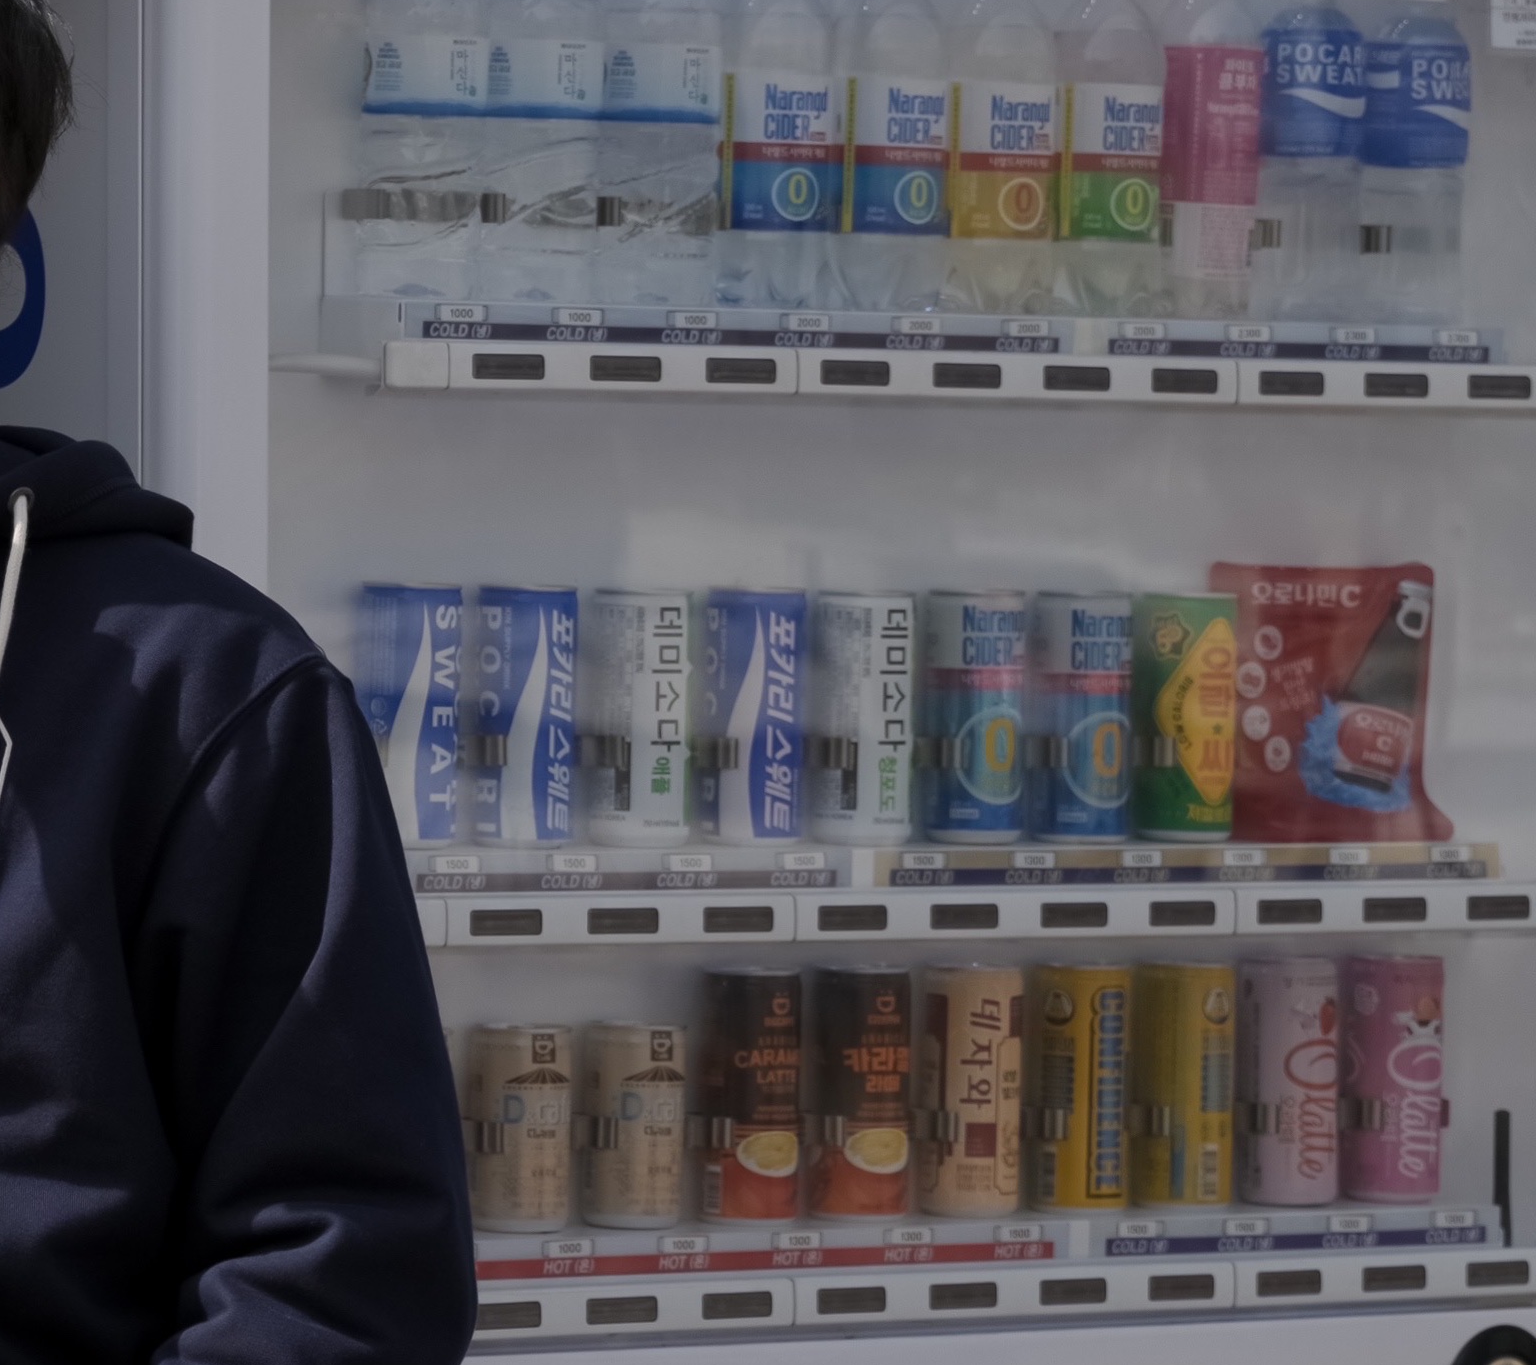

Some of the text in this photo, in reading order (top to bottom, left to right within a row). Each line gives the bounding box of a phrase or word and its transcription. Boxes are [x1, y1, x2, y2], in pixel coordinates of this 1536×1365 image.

[1277, 43, 1364, 65] POCAR
[450, 309, 473, 319] 1000
[568, 313, 591, 323] 1000
[684, 316, 707, 325] 1000
[796, 317, 821, 328] 2000
[908, 320, 933, 331] 2000
[1017, 323, 1040, 334] 2000
[429, 325, 467, 338] COLD
[546, 327, 585, 340] COLD
[661, 330, 699, 343] COLD
[1132, 326, 1155, 336] 2000
[775, 332, 812, 346] COLD
[886, 335, 924, 349] COLD
[995, 338, 1031, 352] COLD
[1114, 341, 1149, 353] COLD
[1220, 343, 1256, 355] COLD
[1251, 583, 1362, 609] 오로나민C
[650, 607, 684, 752] 데미소다
[878, 609, 908, 752] 데미소다
[429, 605, 457, 811] SWEAT
[475, 605, 503, 833] POCRI
[546, 609, 574, 832] 포카리 스웨트
[764, 611, 796, 832] 포카리 스웨트
[650, 756, 671, 794] 애플
[878, 756, 898, 814] 청포도
[446, 860, 468, 869] 1500
[563, 858, 586, 868] 1500
[679, 858, 702, 868] 1500
[793, 856, 815, 866] 1500
[912, 855, 935, 865] 1500
[1023, 855, 1045, 865] 1300
[423, 875, 463, 889] COLD
[541, 875, 580, 889] COLD
[657, 873, 694, 888] COLD
[770, 872, 808, 886] COLD
[895, 870, 932, 884] COLD
[1005, 870, 1040, 884] COLD
[959, 998, 1001, 1109] 데자와
[788, 1236, 811, 1246] 1300
[900, 1231, 922, 1241] 1300
[558, 1243, 581, 1253] 1000
[672, 1240, 695, 1250] 1000
[994, 1245, 1022, 1259] HOT
[772, 1252, 800, 1266] HOT
[884, 1249, 911, 1262] HOT
[543, 1260, 572, 1274] HOT
[658, 1256, 687, 1270] HOT
